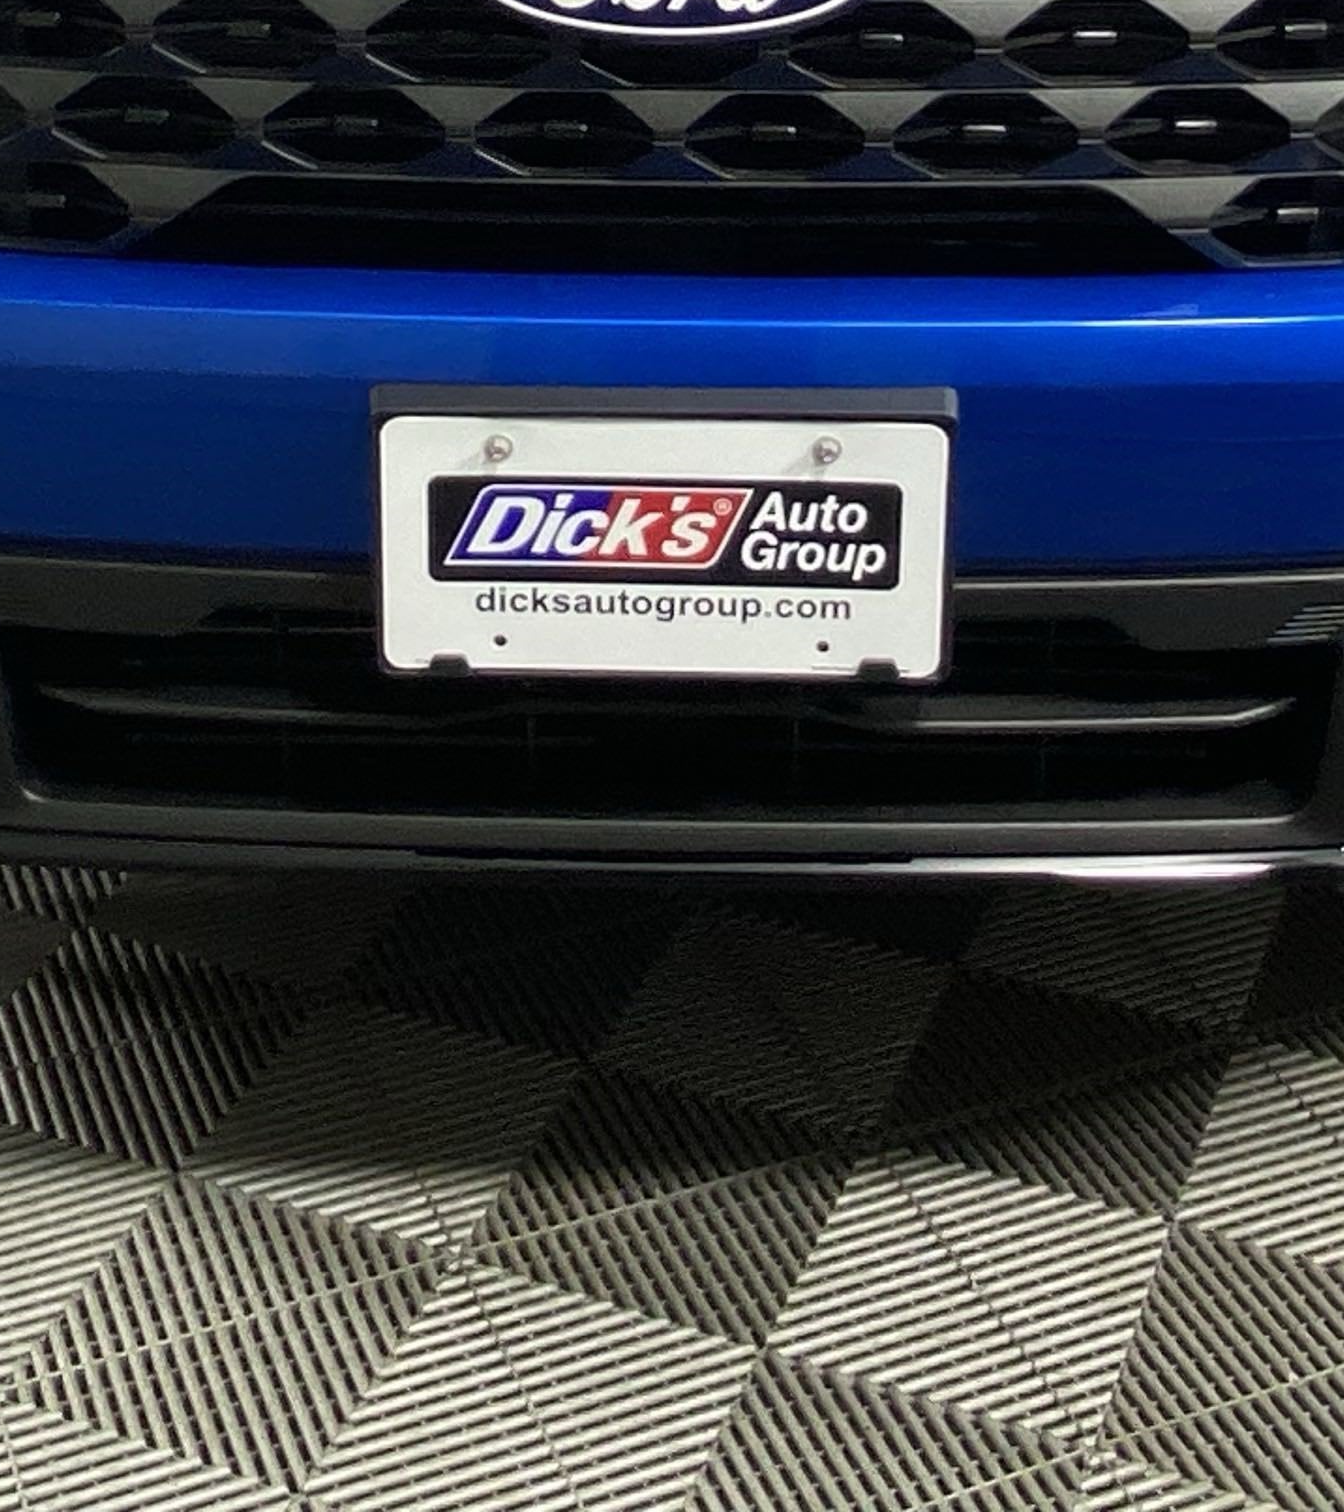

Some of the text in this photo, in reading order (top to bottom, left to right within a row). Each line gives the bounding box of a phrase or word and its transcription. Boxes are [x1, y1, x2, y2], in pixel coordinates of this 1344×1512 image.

[749, 491, 869, 534] Auto
[740, 530, 887, 582] Group
[475, 586, 852, 623] dicksautogroup.com
